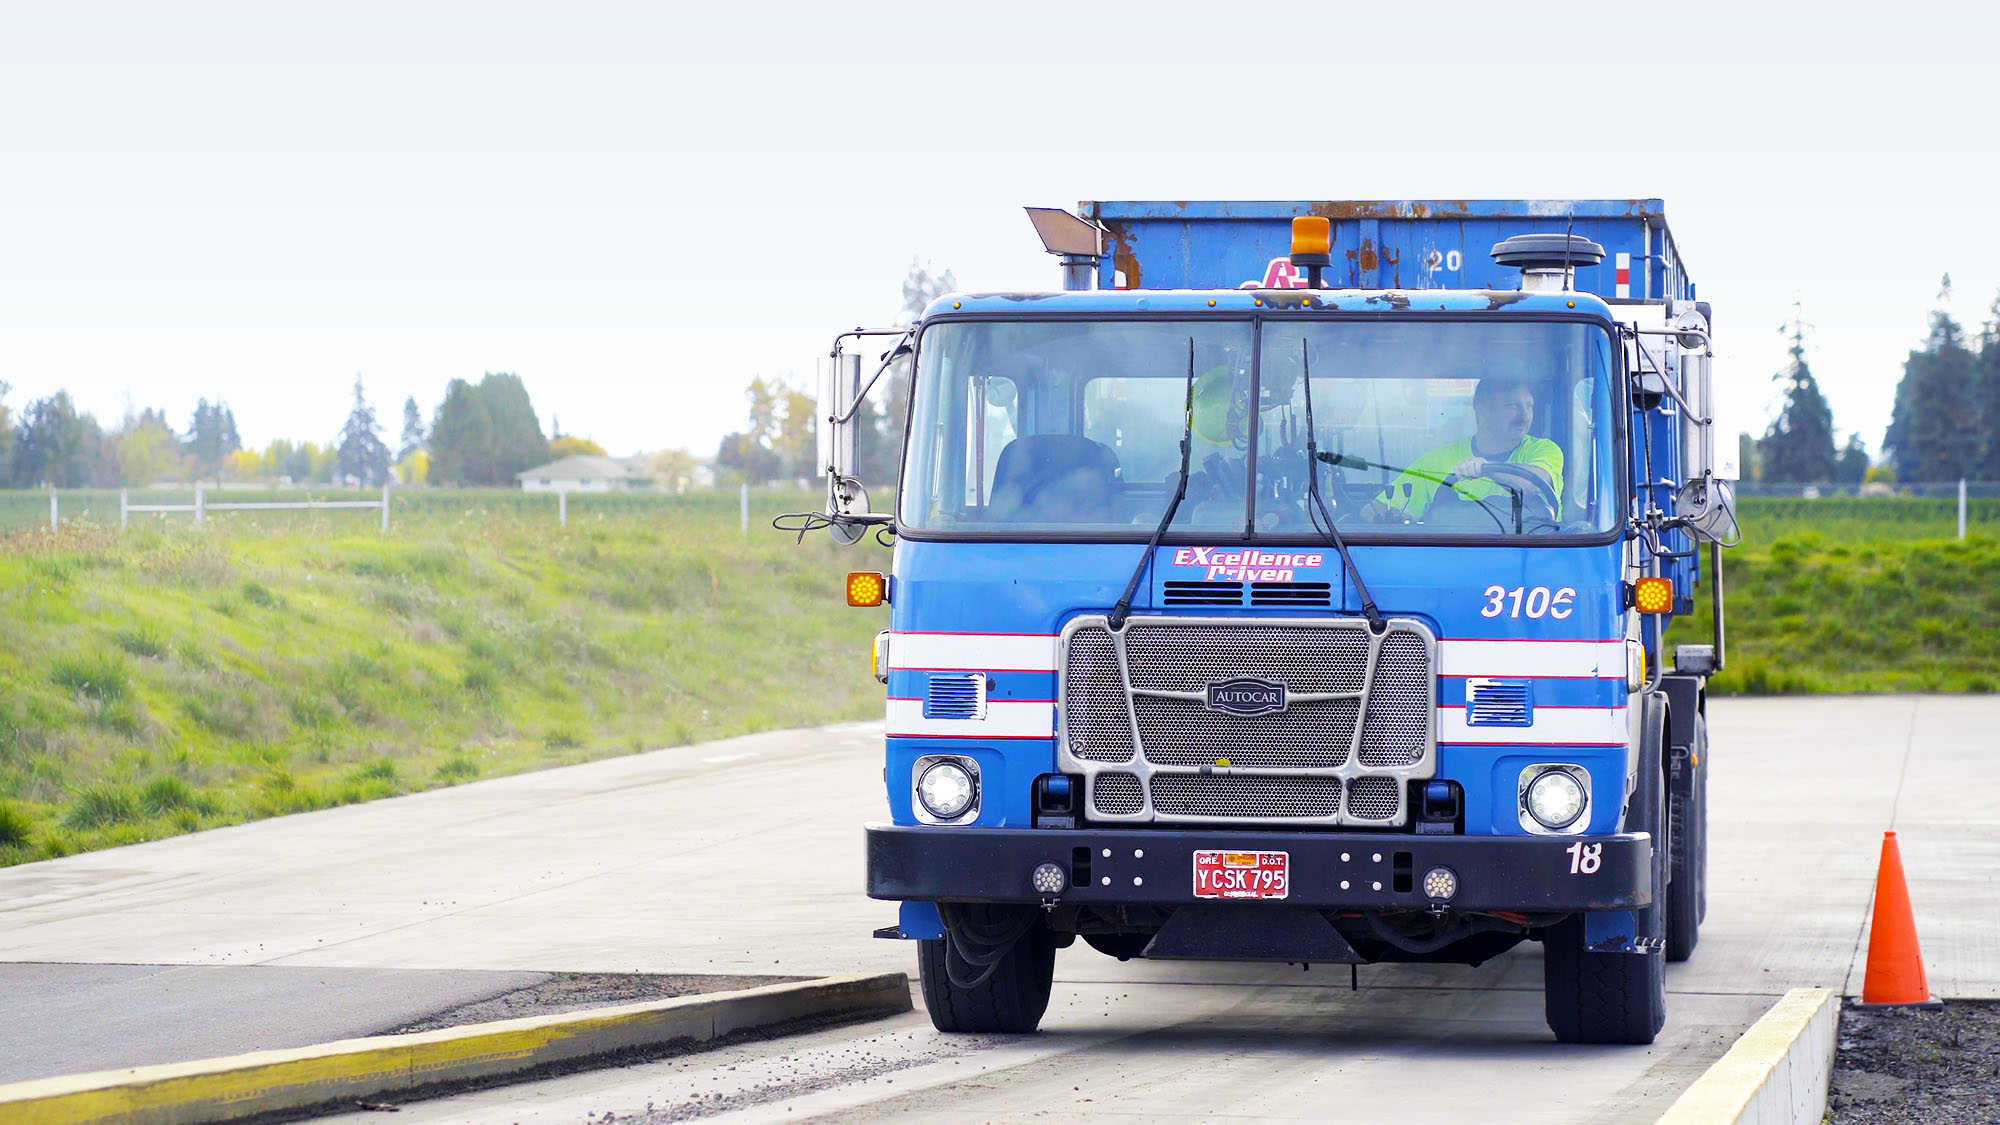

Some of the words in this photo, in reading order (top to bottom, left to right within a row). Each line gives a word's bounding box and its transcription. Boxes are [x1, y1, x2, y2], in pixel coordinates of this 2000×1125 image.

[1429, 249, 1463, 272] 20
[1172, 546, 1323, 568] EXcellence
[1480, 584, 1577, 620] 3106
[1215, 690, 1278, 703] AUTOCAR
[1199, 857, 1220, 865] ORE.
[1261, 857, 1285, 866] D.O.T.
[1566, 841, 1602, 874] 18
